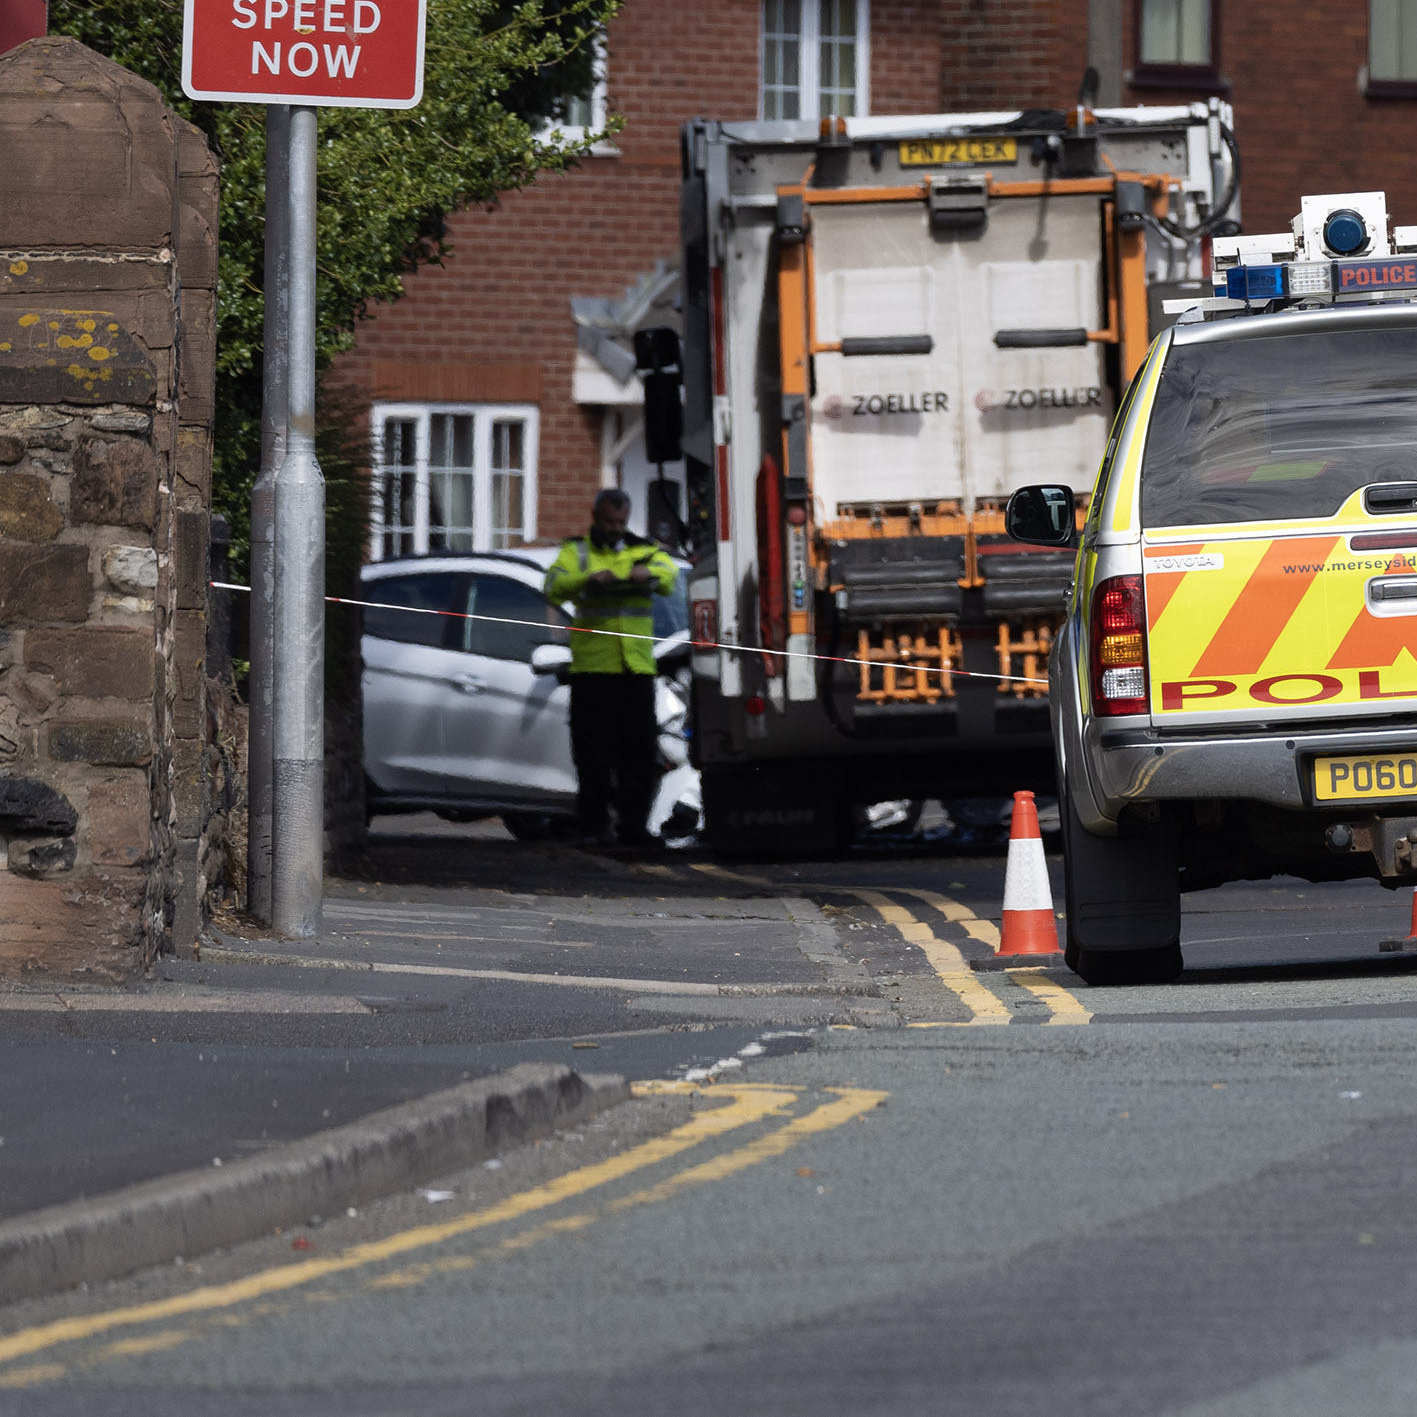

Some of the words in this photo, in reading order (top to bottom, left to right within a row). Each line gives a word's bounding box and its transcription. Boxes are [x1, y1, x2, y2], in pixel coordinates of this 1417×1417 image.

[251, 40, 362, 79] NOW
[1341, 265, 1417, 287] POLICE
[852, 391, 949, 417] ZOELLER
[1153, 556, 1215, 569] TOYOTA
[1329, 759, 1417, 793] PO60
